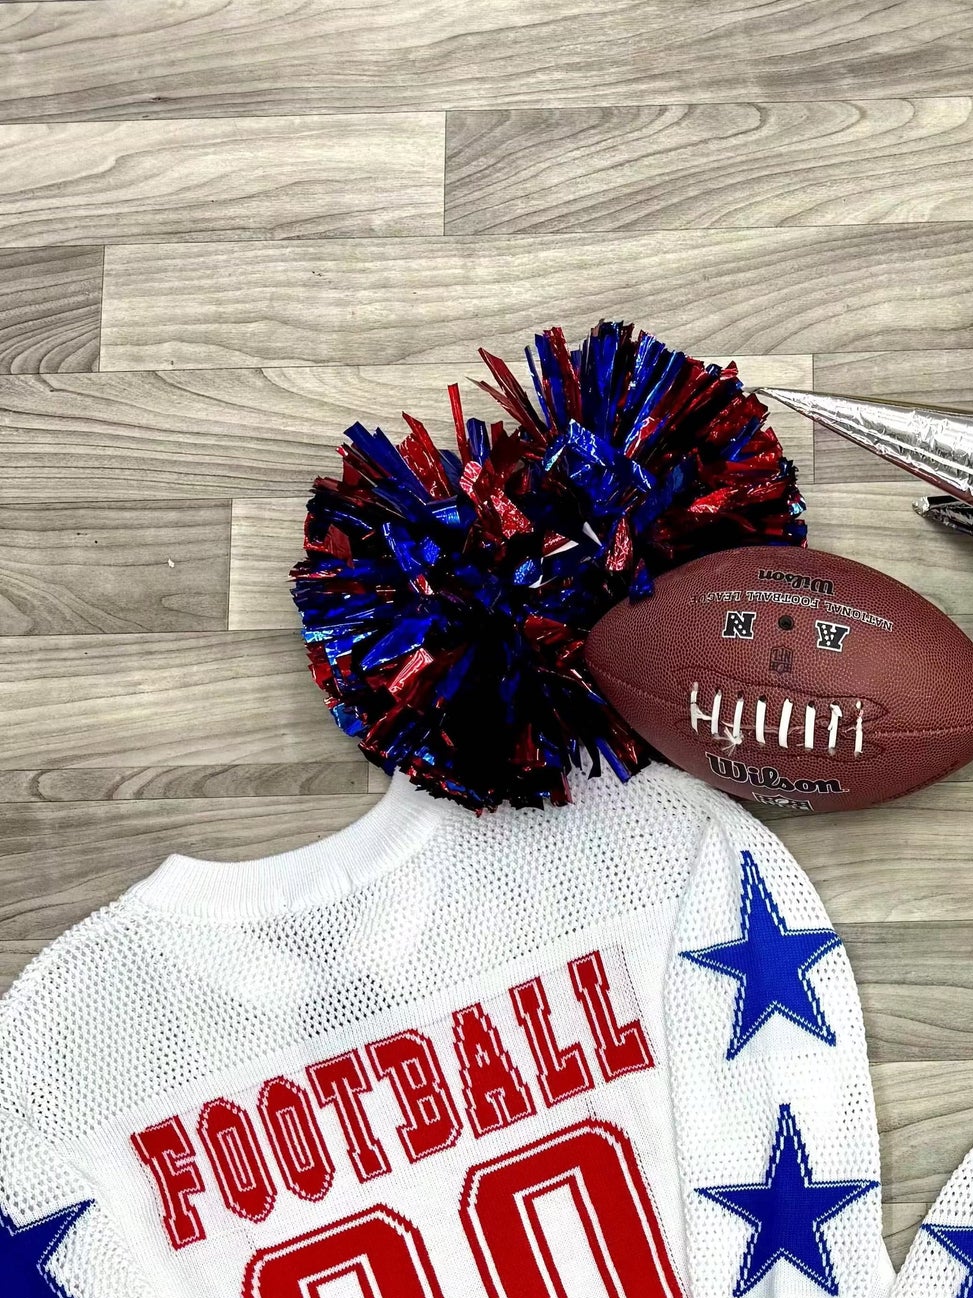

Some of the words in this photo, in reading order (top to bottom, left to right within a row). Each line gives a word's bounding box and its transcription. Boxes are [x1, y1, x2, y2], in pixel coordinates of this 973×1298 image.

[758, 569, 835, 595] Wilson
[746, 590, 819, 609] FOOTBALL
[825, 600, 893, 632] NATIONAL
[705, 751, 849, 793] Wilson
[131, 951, 655, 1250] FOOTBALL
